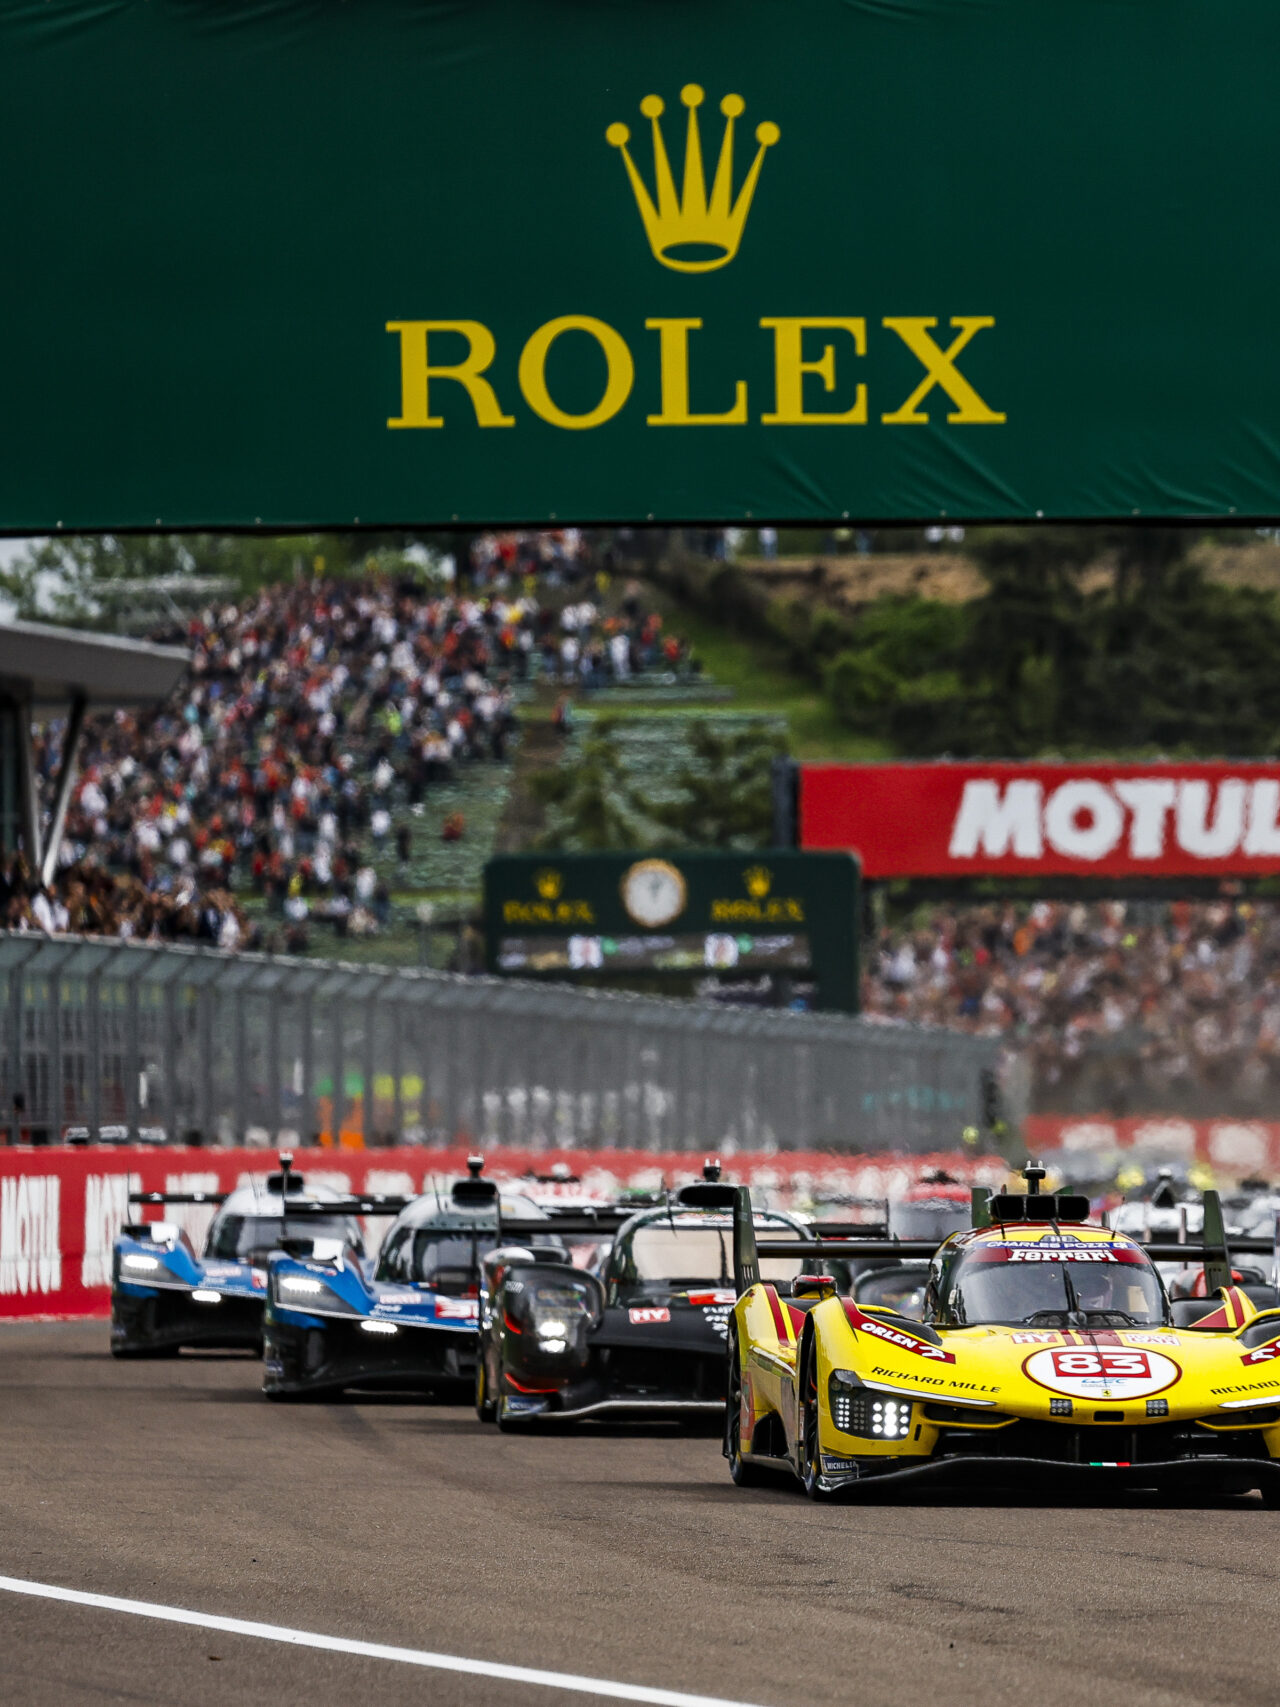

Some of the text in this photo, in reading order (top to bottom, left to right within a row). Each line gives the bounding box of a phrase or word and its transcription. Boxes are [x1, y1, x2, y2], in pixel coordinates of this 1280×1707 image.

[386, 316, 1006, 430] ROLEX
[1008, 1249, 1119, 1263] Ferrari
[632, 1309, 665, 1321] HY
[861, 1322, 918, 1349] ORLEN
[1058, 1354, 1146, 1375] 83
[871, 1366, 1001, 1394] RICHARD MILLE
[1210, 1380, 1280, 1396] RICHARD
